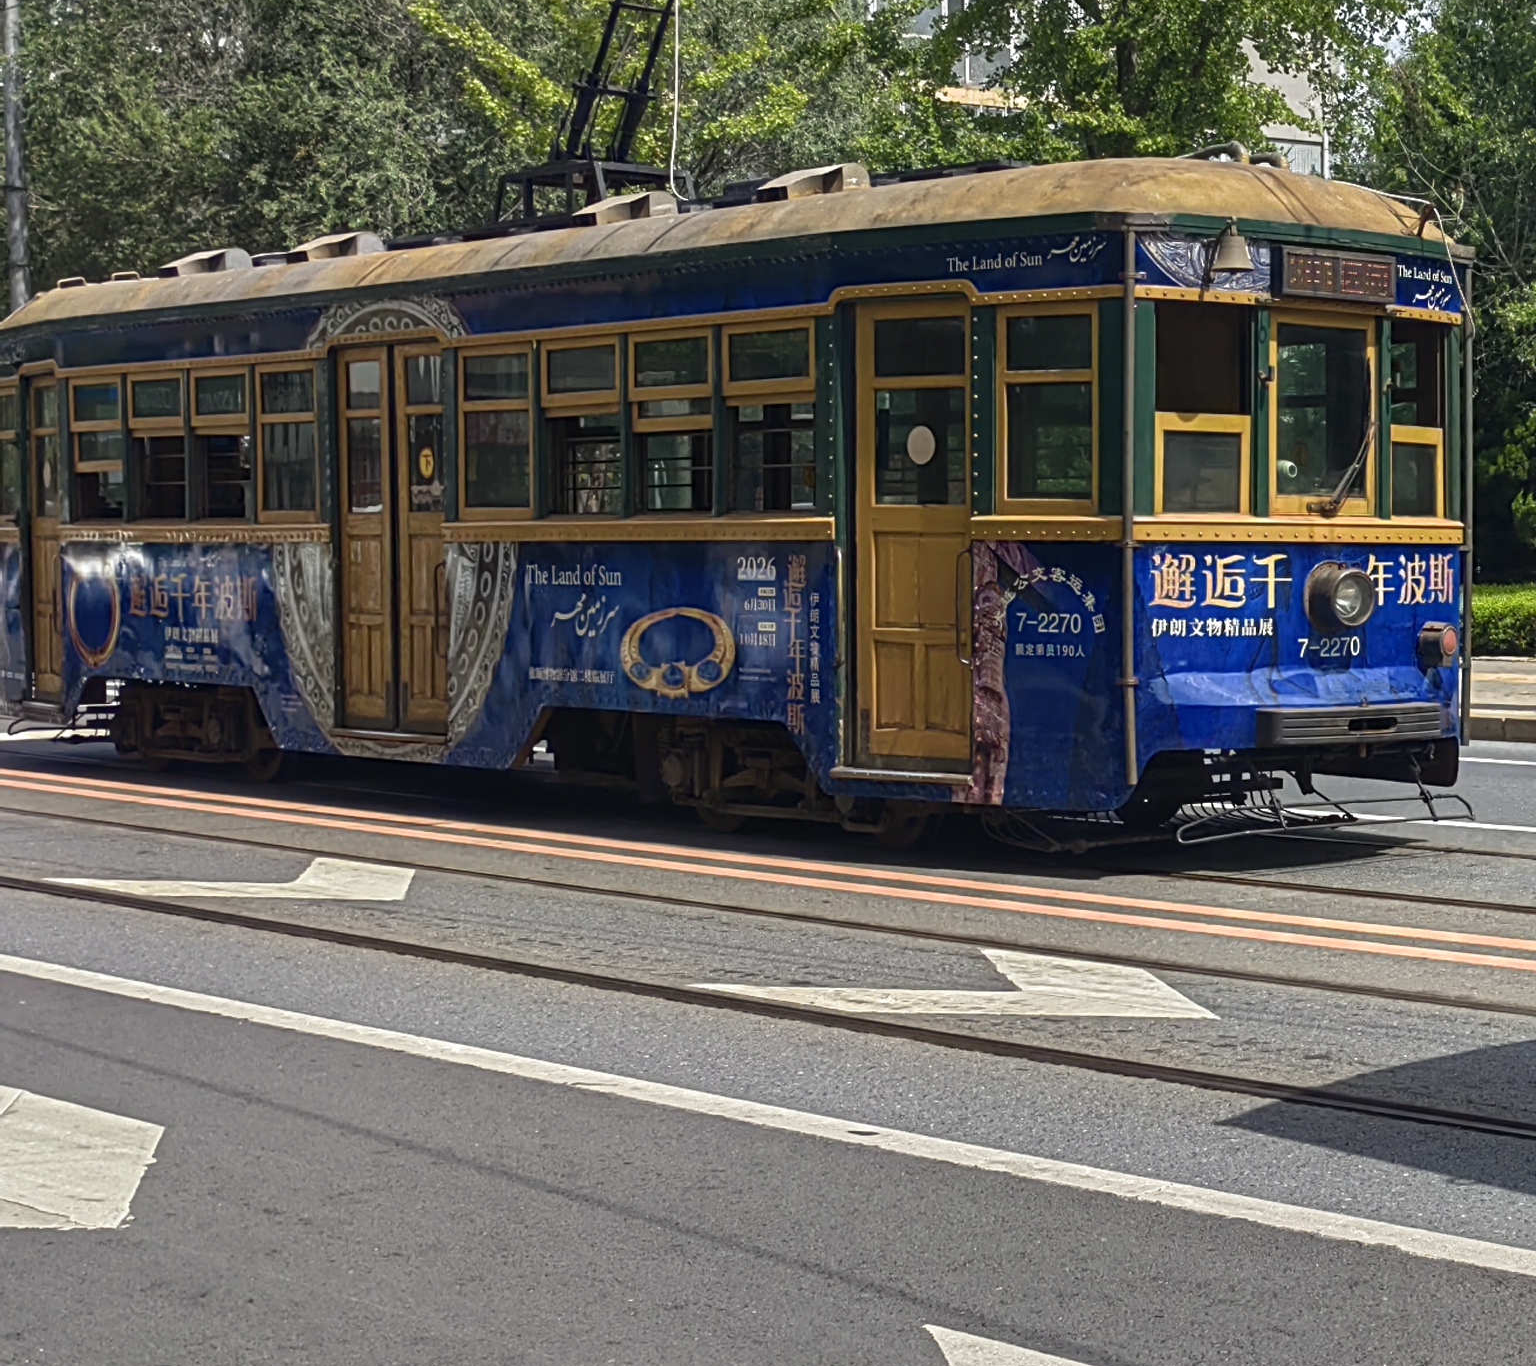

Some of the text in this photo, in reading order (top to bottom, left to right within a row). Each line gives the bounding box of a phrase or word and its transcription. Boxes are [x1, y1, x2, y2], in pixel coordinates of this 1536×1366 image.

[947, 251, 1042, 272] The Land of Sun
[1397, 265, 1453, 285] The Land of Sun
[526, 564, 622, 586] The Land of Sun
[737, 556, 777, 580] 2026
[1148, 553, 1454, 609] 邂逅千 年波斯
[1016, 612, 1082, 634] 7-2270
[1151, 618, 1274, 638] 伊朗文物精品展
[783, 553, 807, 735] 邂逅千年波斯
[809, 592, 821, 705] 伊朗文物精品展
[1297, 636, 1361, 658] 7-2270
